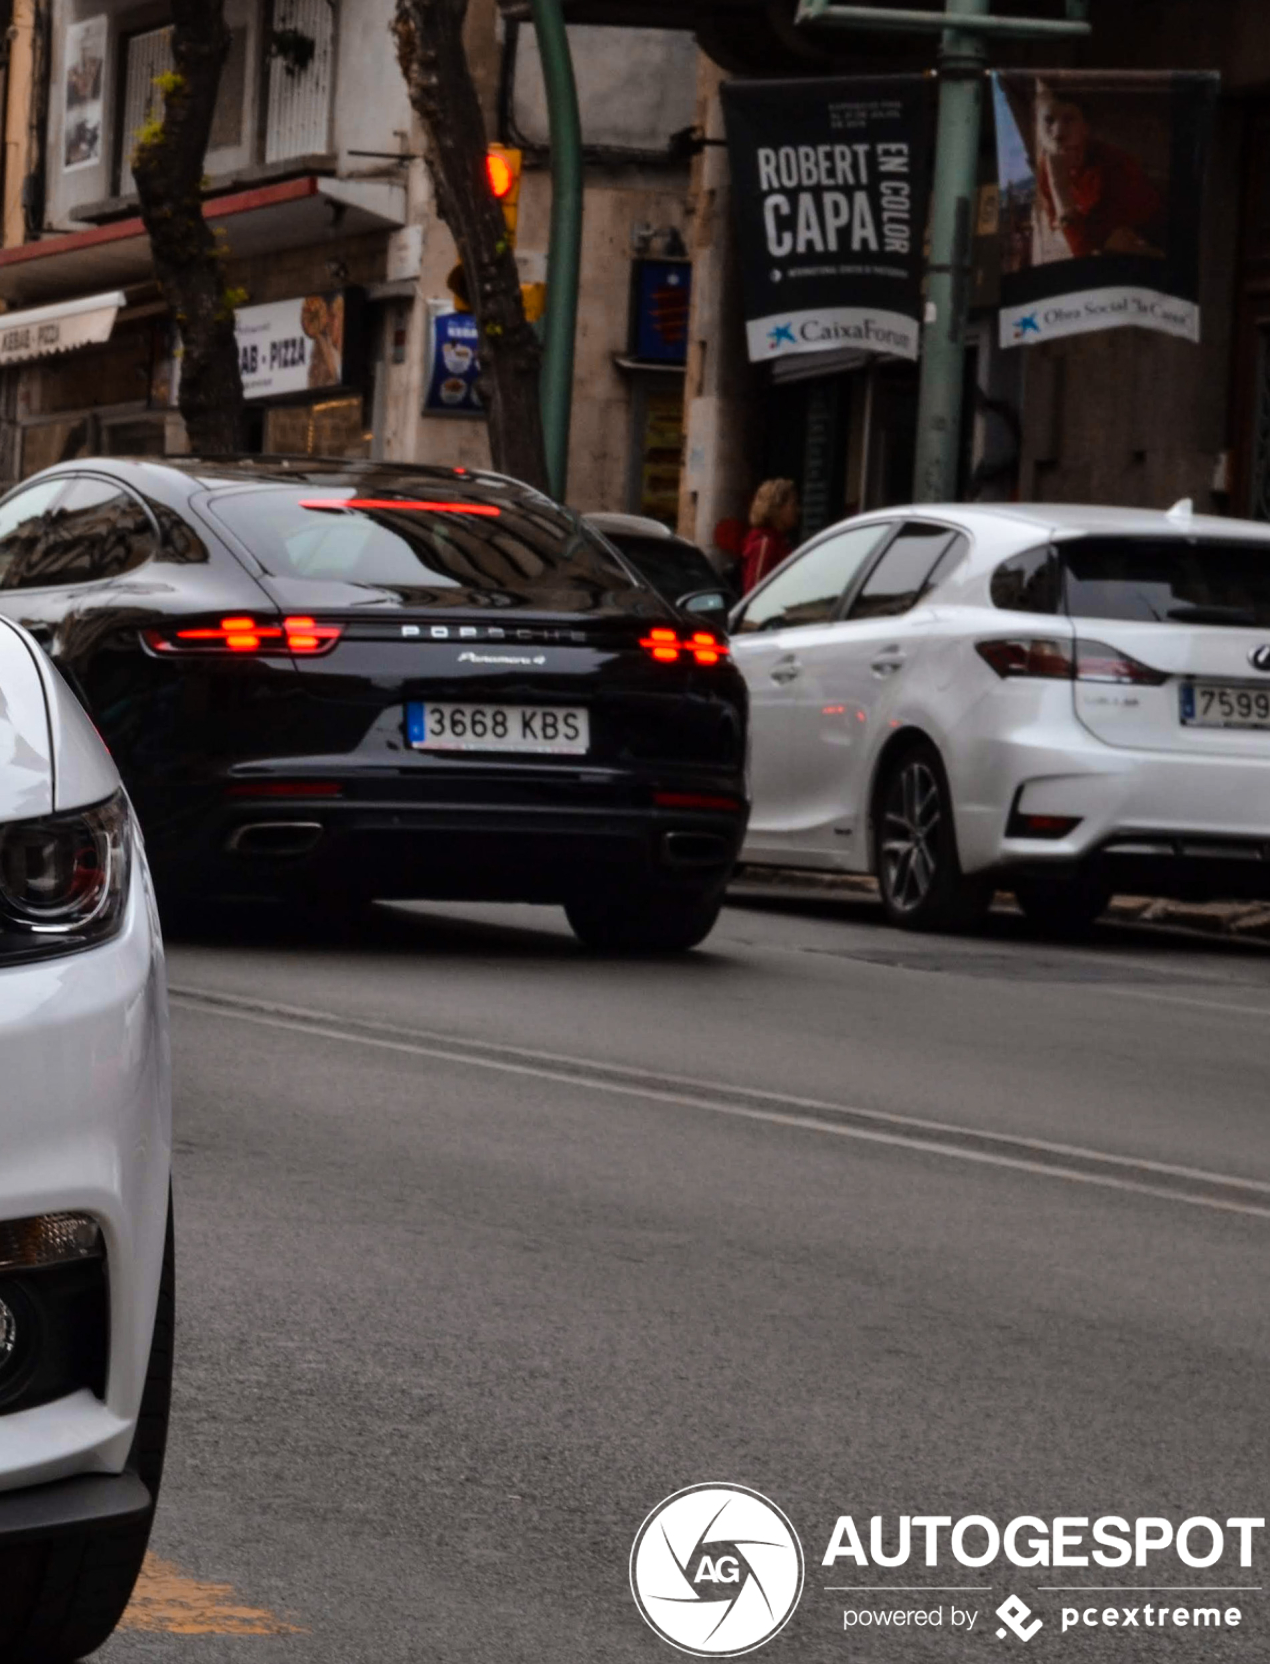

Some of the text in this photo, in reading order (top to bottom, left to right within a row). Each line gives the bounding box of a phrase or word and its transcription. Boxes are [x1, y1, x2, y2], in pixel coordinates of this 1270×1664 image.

[757, 143, 871, 191] ROBERT
[876, 142, 910, 255] EN COLOR
[763, 190, 879, 258] CAPA
[1084, 299, 1128, 315] Social
[799, 318, 911, 348] CaixaForum
[269, 335, 306, 372] PIZZA
[401, 624, 587, 643] PORSCHE
[1200, 689, 1270, 720] 7599
[429, 707, 580, 742] 3668 KBS
